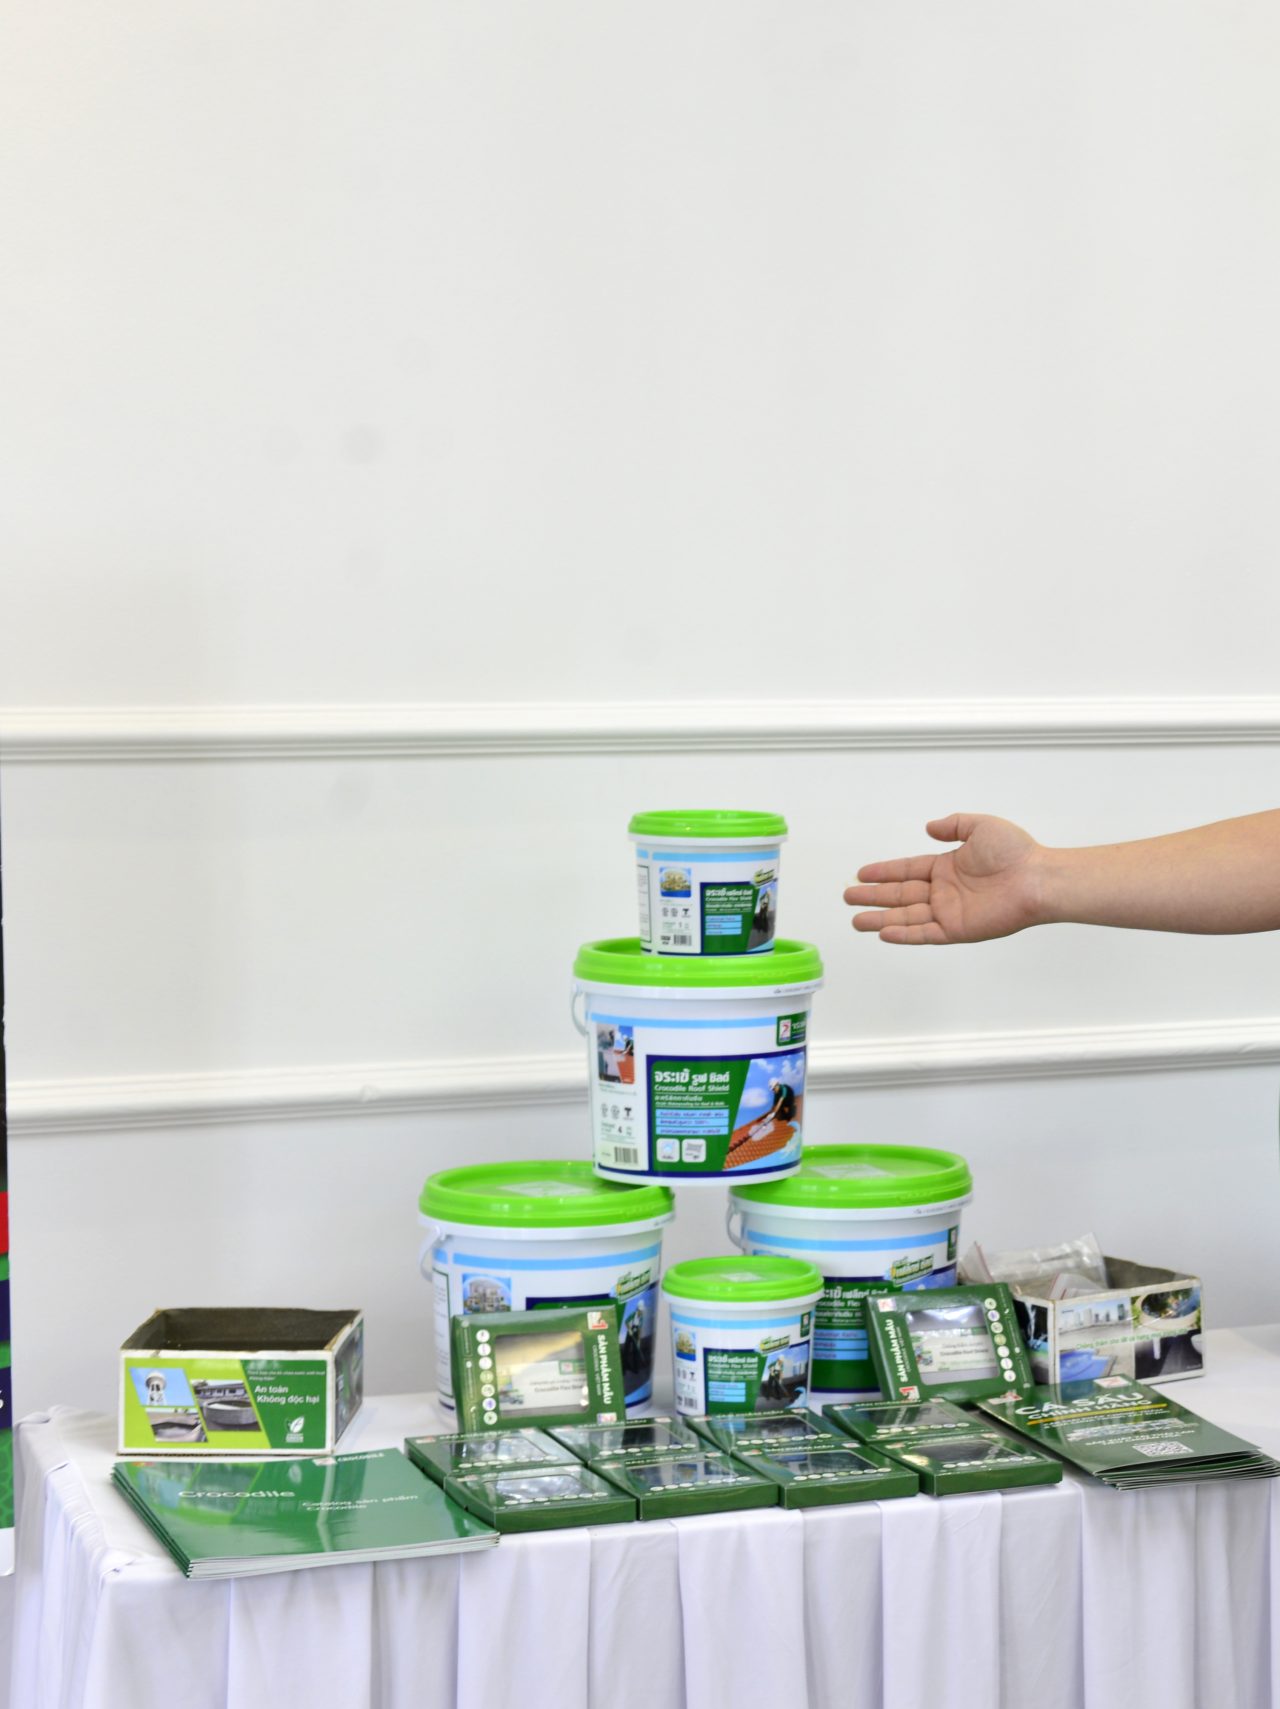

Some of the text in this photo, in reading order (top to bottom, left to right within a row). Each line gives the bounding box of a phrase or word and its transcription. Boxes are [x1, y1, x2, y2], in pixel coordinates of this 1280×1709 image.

[655, 1067, 690, 1083] จระเข้
[655, 1084, 730, 1092] Crocodile Roof Shield
[885, 1319, 909, 1383] SẢN PHẨM MẪU
[597, 1334, 614, 1405] SẢN PHẨM MẪU
[255, 1385, 288, 1393] An toàn
[257, 1394, 320, 1405] Không độc hại
[1071, 1391, 1145, 1408] SẤU
[178, 1490, 296, 1498] Crocodile
